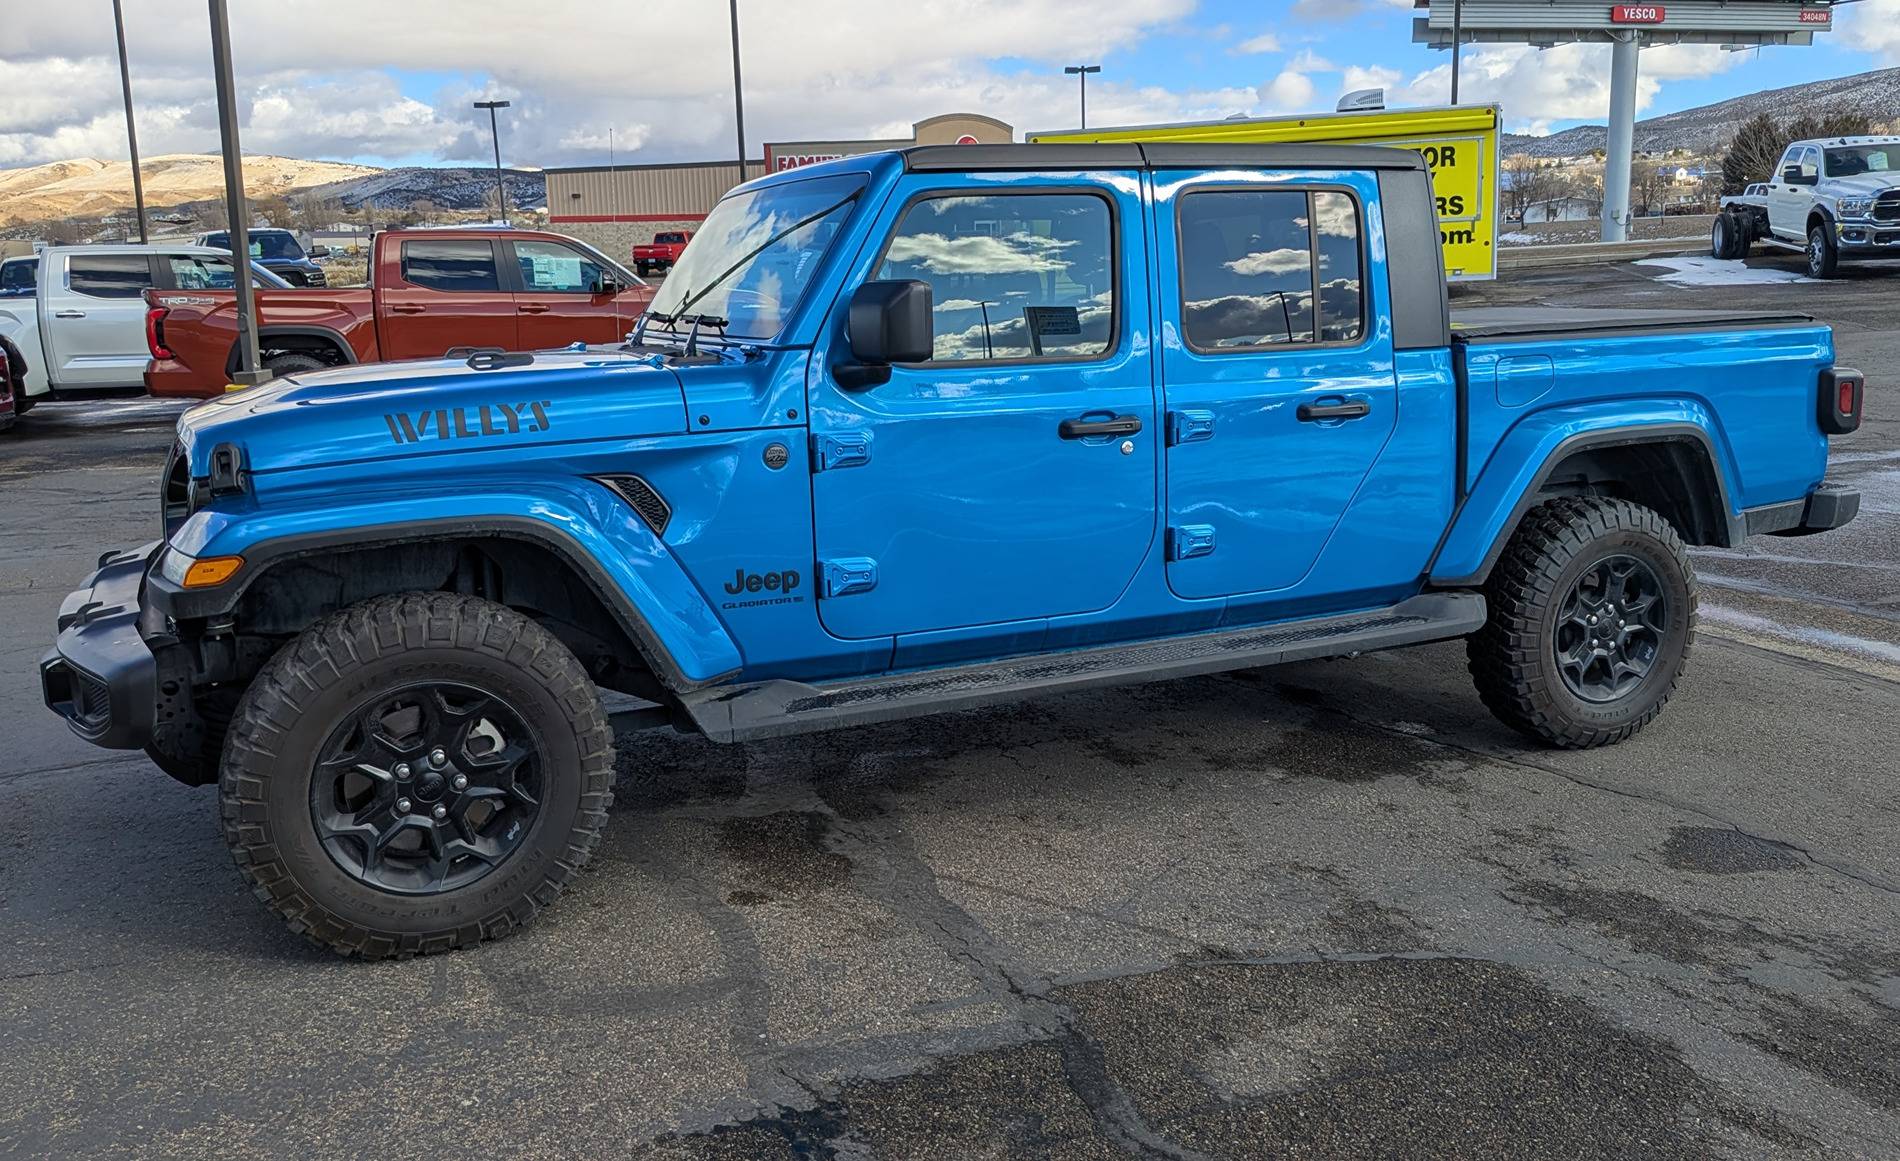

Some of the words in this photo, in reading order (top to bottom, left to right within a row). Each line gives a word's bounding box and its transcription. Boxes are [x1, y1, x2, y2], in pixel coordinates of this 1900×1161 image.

[1623, 8, 1656, 19] YESCO
[777, 155, 842, 172] FAM
[1416, 146, 1456, 168] OR
[384, 400, 551, 444] WILLYS
[723, 568, 800, 595] Jeep
[722, 597, 792, 610] GLADIATOR
